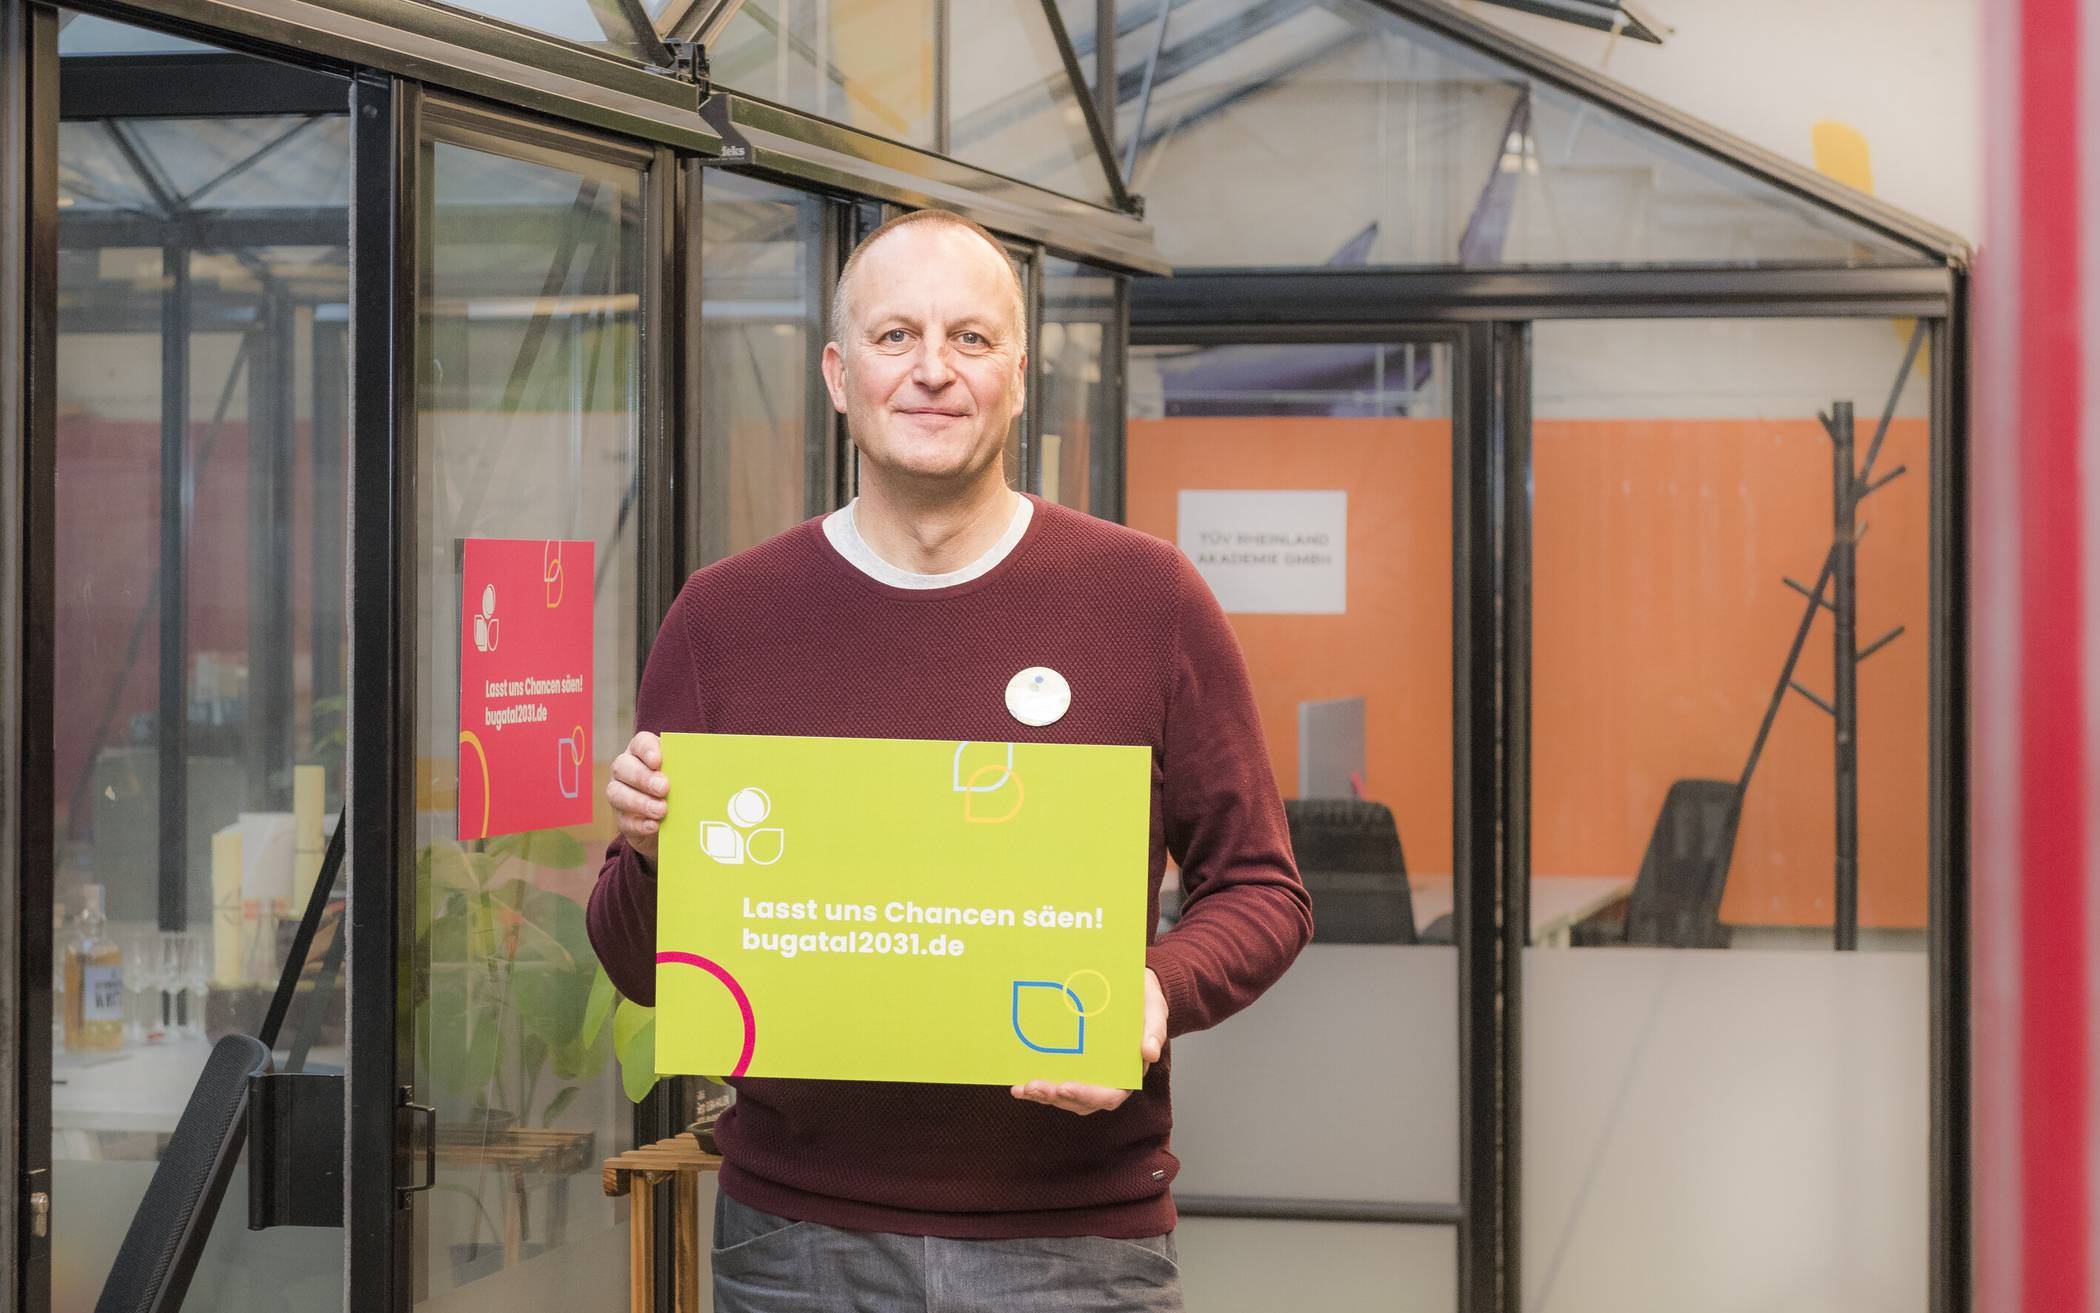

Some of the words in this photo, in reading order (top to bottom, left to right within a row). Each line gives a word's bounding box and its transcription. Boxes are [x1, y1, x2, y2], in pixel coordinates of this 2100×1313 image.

[1201, 530, 1232, 545] TÜV
[1237, 532, 1330, 545] RHEINLAND
[1198, 553, 1279, 566] AKADEMIE
[1284, 553, 1332, 566] GMBH
[485, 679, 508, 698] Lasst
[509, 681, 524, 697] uns
[525, 677, 560, 696] Chancen
[561, 674, 583, 693] säen!
[485, 703, 548, 731] bugatal2031.de
[743, 897, 818, 919] Lasst
[825, 902, 877, 923] uns
[885, 902, 1015, 926] Chancen
[1023, 905, 1104, 929] säen!
[743, 928, 965, 958] bugatal2031.de
